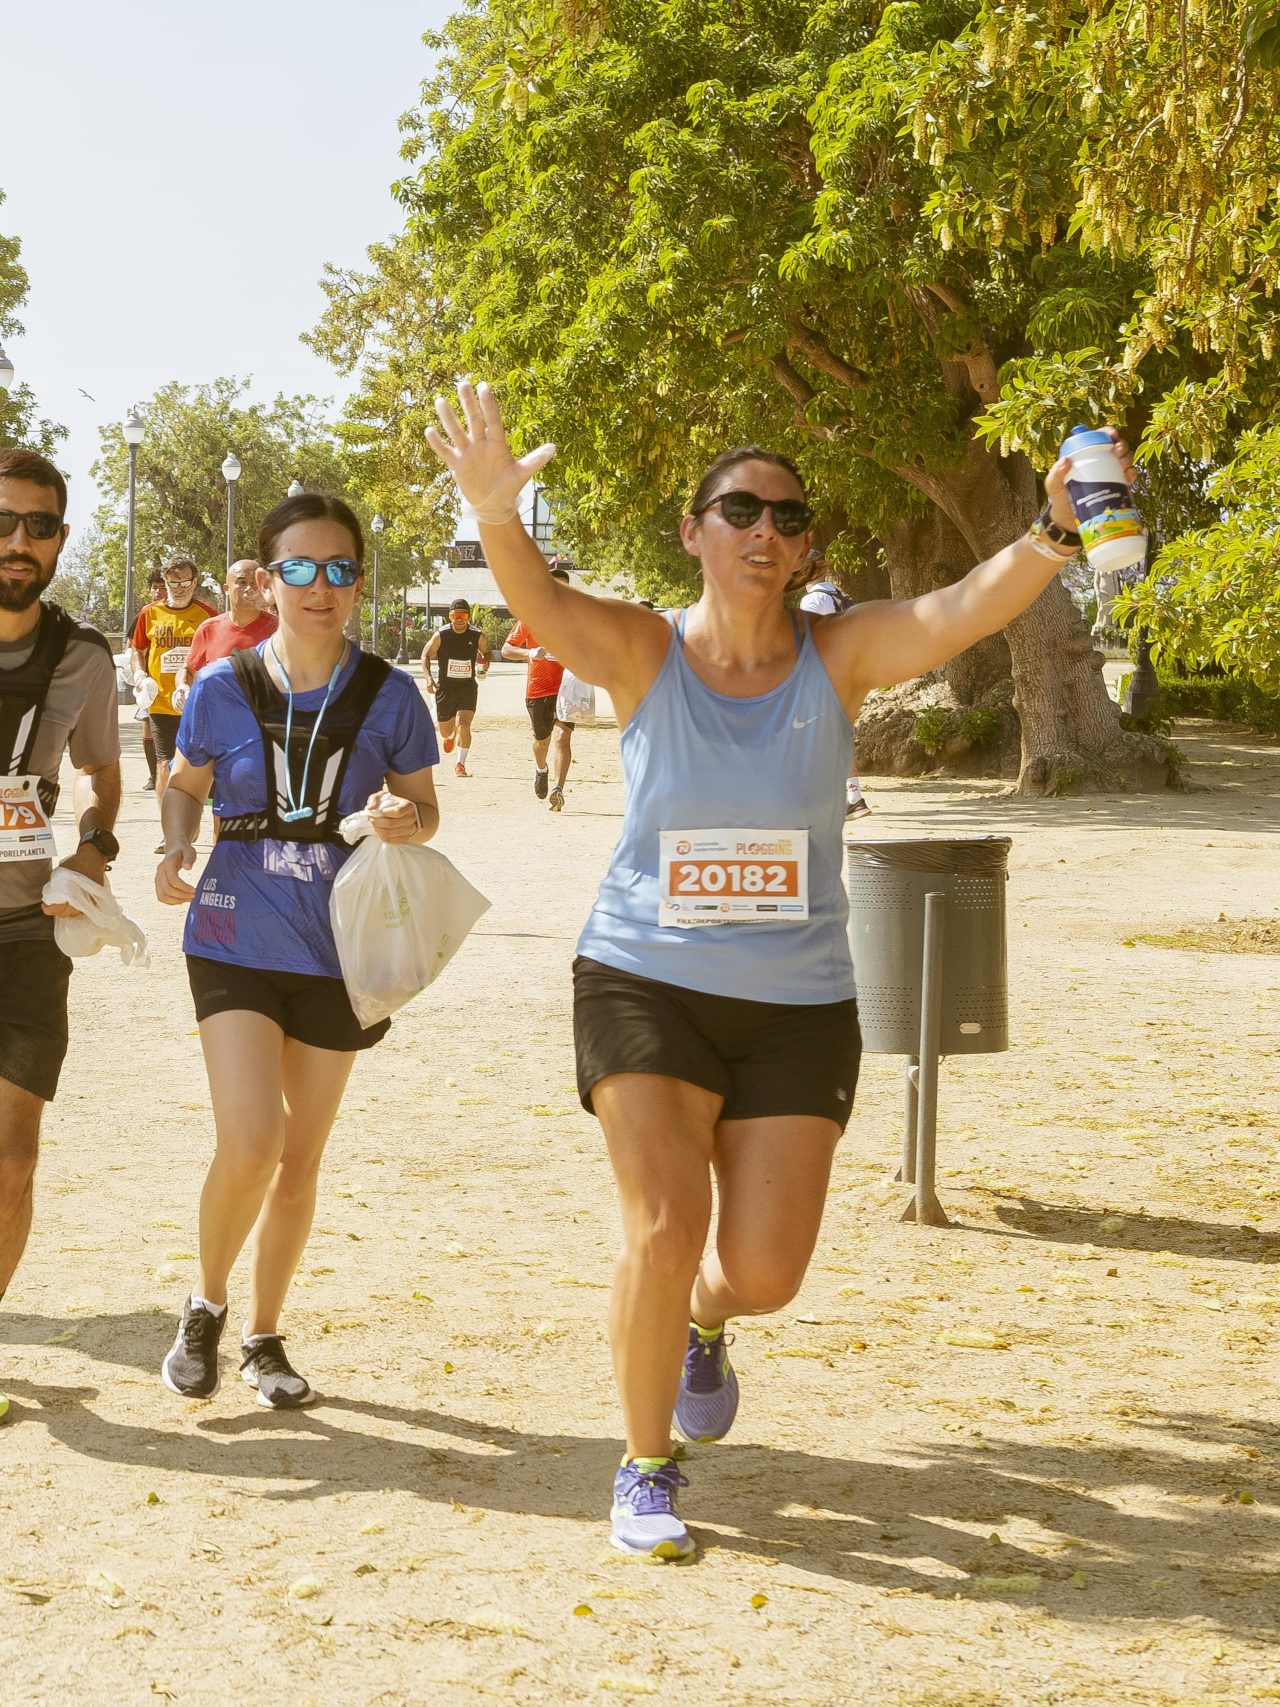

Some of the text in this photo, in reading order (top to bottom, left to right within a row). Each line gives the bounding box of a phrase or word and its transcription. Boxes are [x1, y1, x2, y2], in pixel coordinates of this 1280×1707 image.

[154, 625, 174, 637] RUN
[203, 878, 218, 892] LOS
[677, 864, 788, 893] 20182
[199, 892, 237, 910] ANGELES
